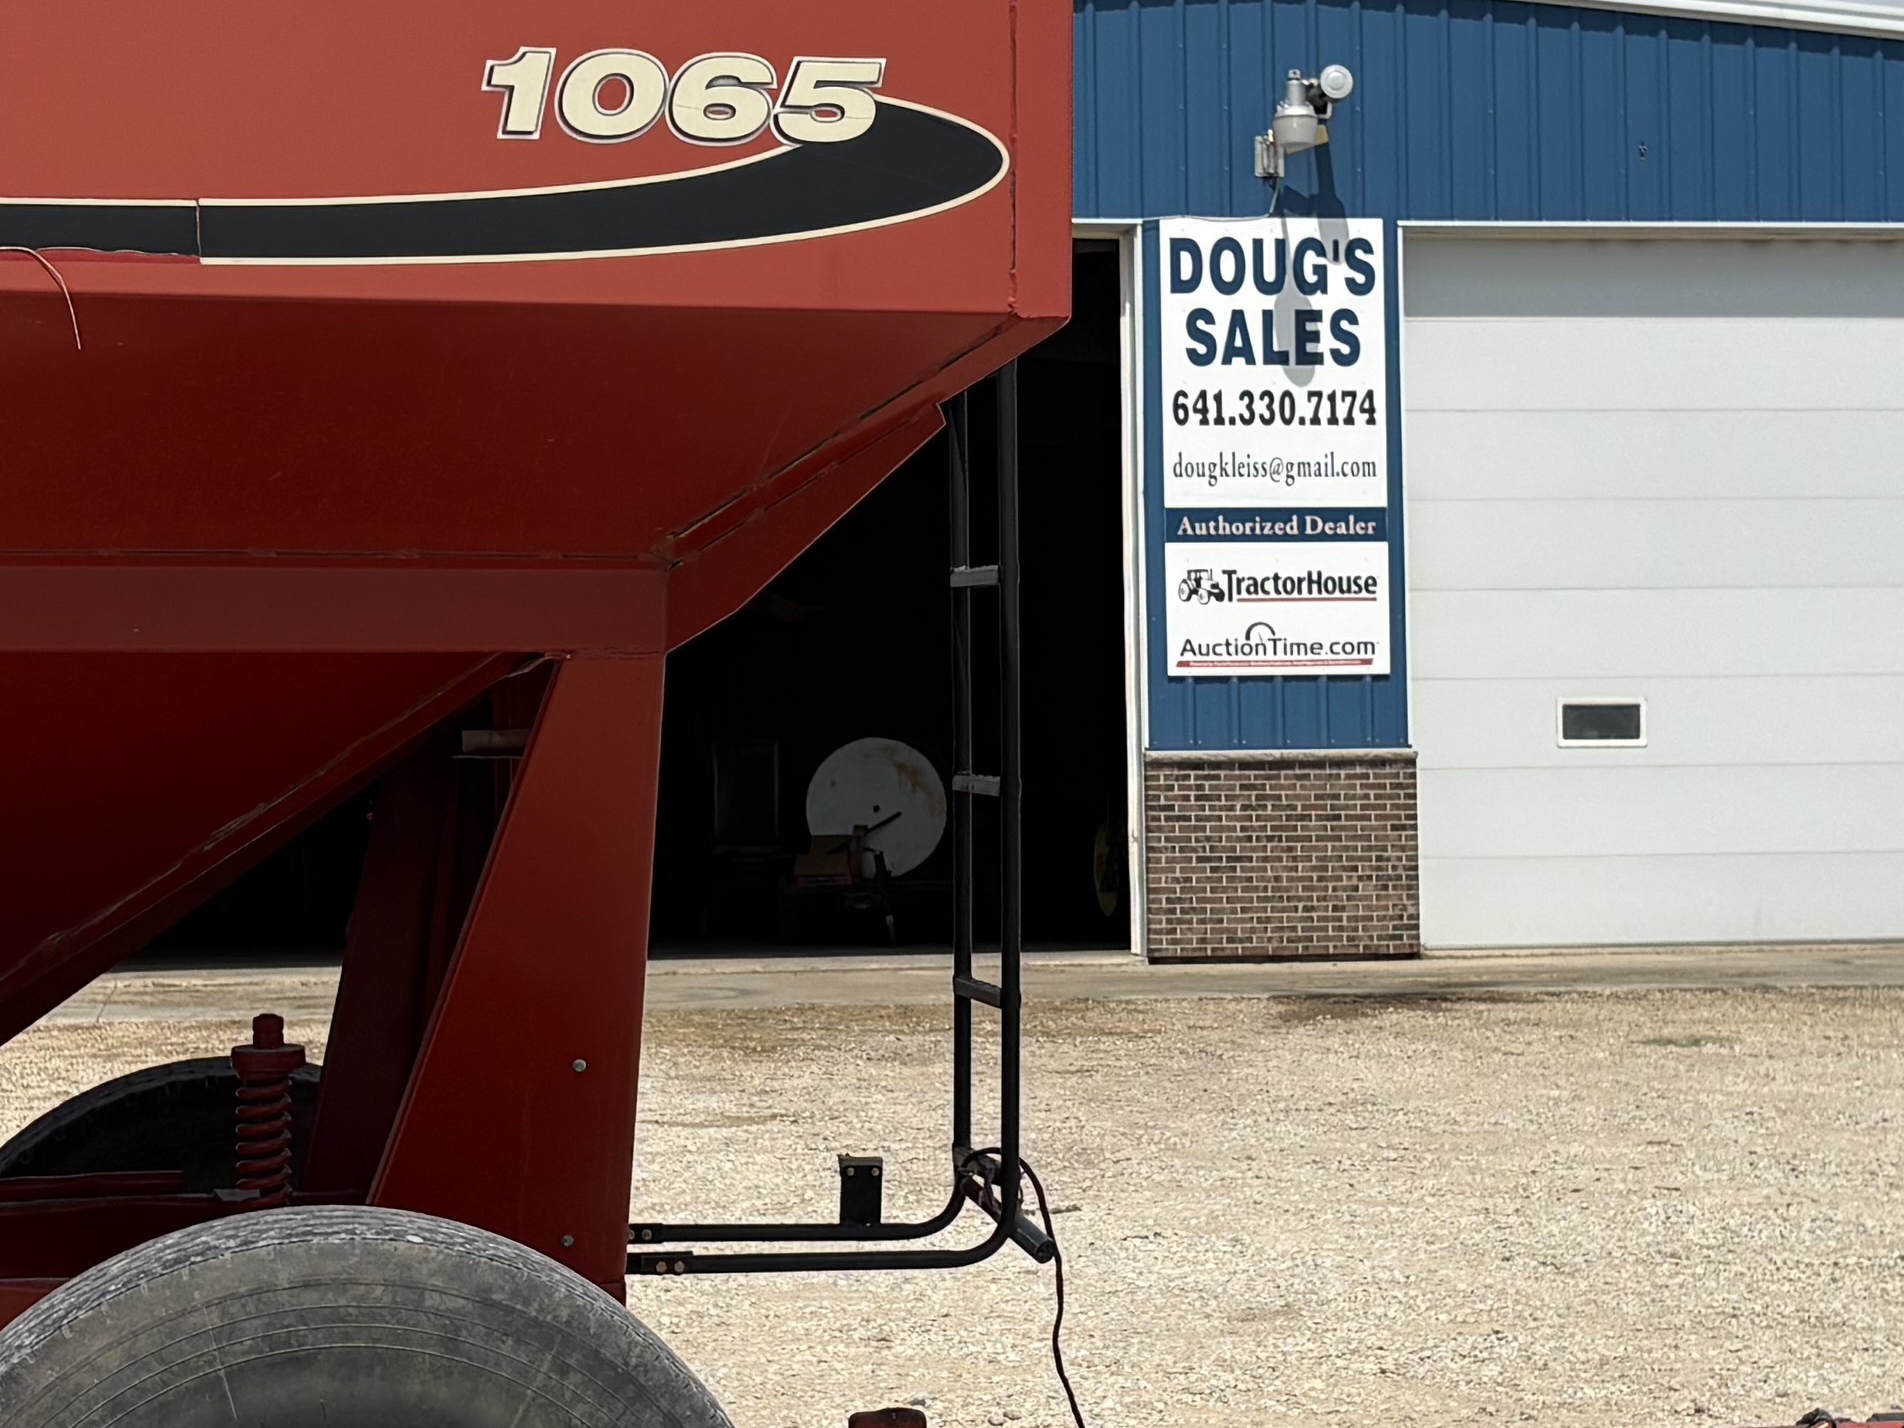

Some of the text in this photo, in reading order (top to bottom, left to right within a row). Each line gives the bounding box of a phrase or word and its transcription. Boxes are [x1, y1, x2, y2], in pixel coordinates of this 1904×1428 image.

[481, 46, 886, 147] 1065
[1169, 236, 1376, 296] DOUG'S
[1185, 307, 1362, 367] SALES
[1172, 388, 1377, 427] 641.330.7174
[1172, 451, 1377, 487] dougkleiss@gmail.com
[1176, 515, 1377, 537] Authorized Dealer
[1222, 569, 1378, 603] TractorHouse
[1179, 637, 1376, 657] AuctionTime.com
